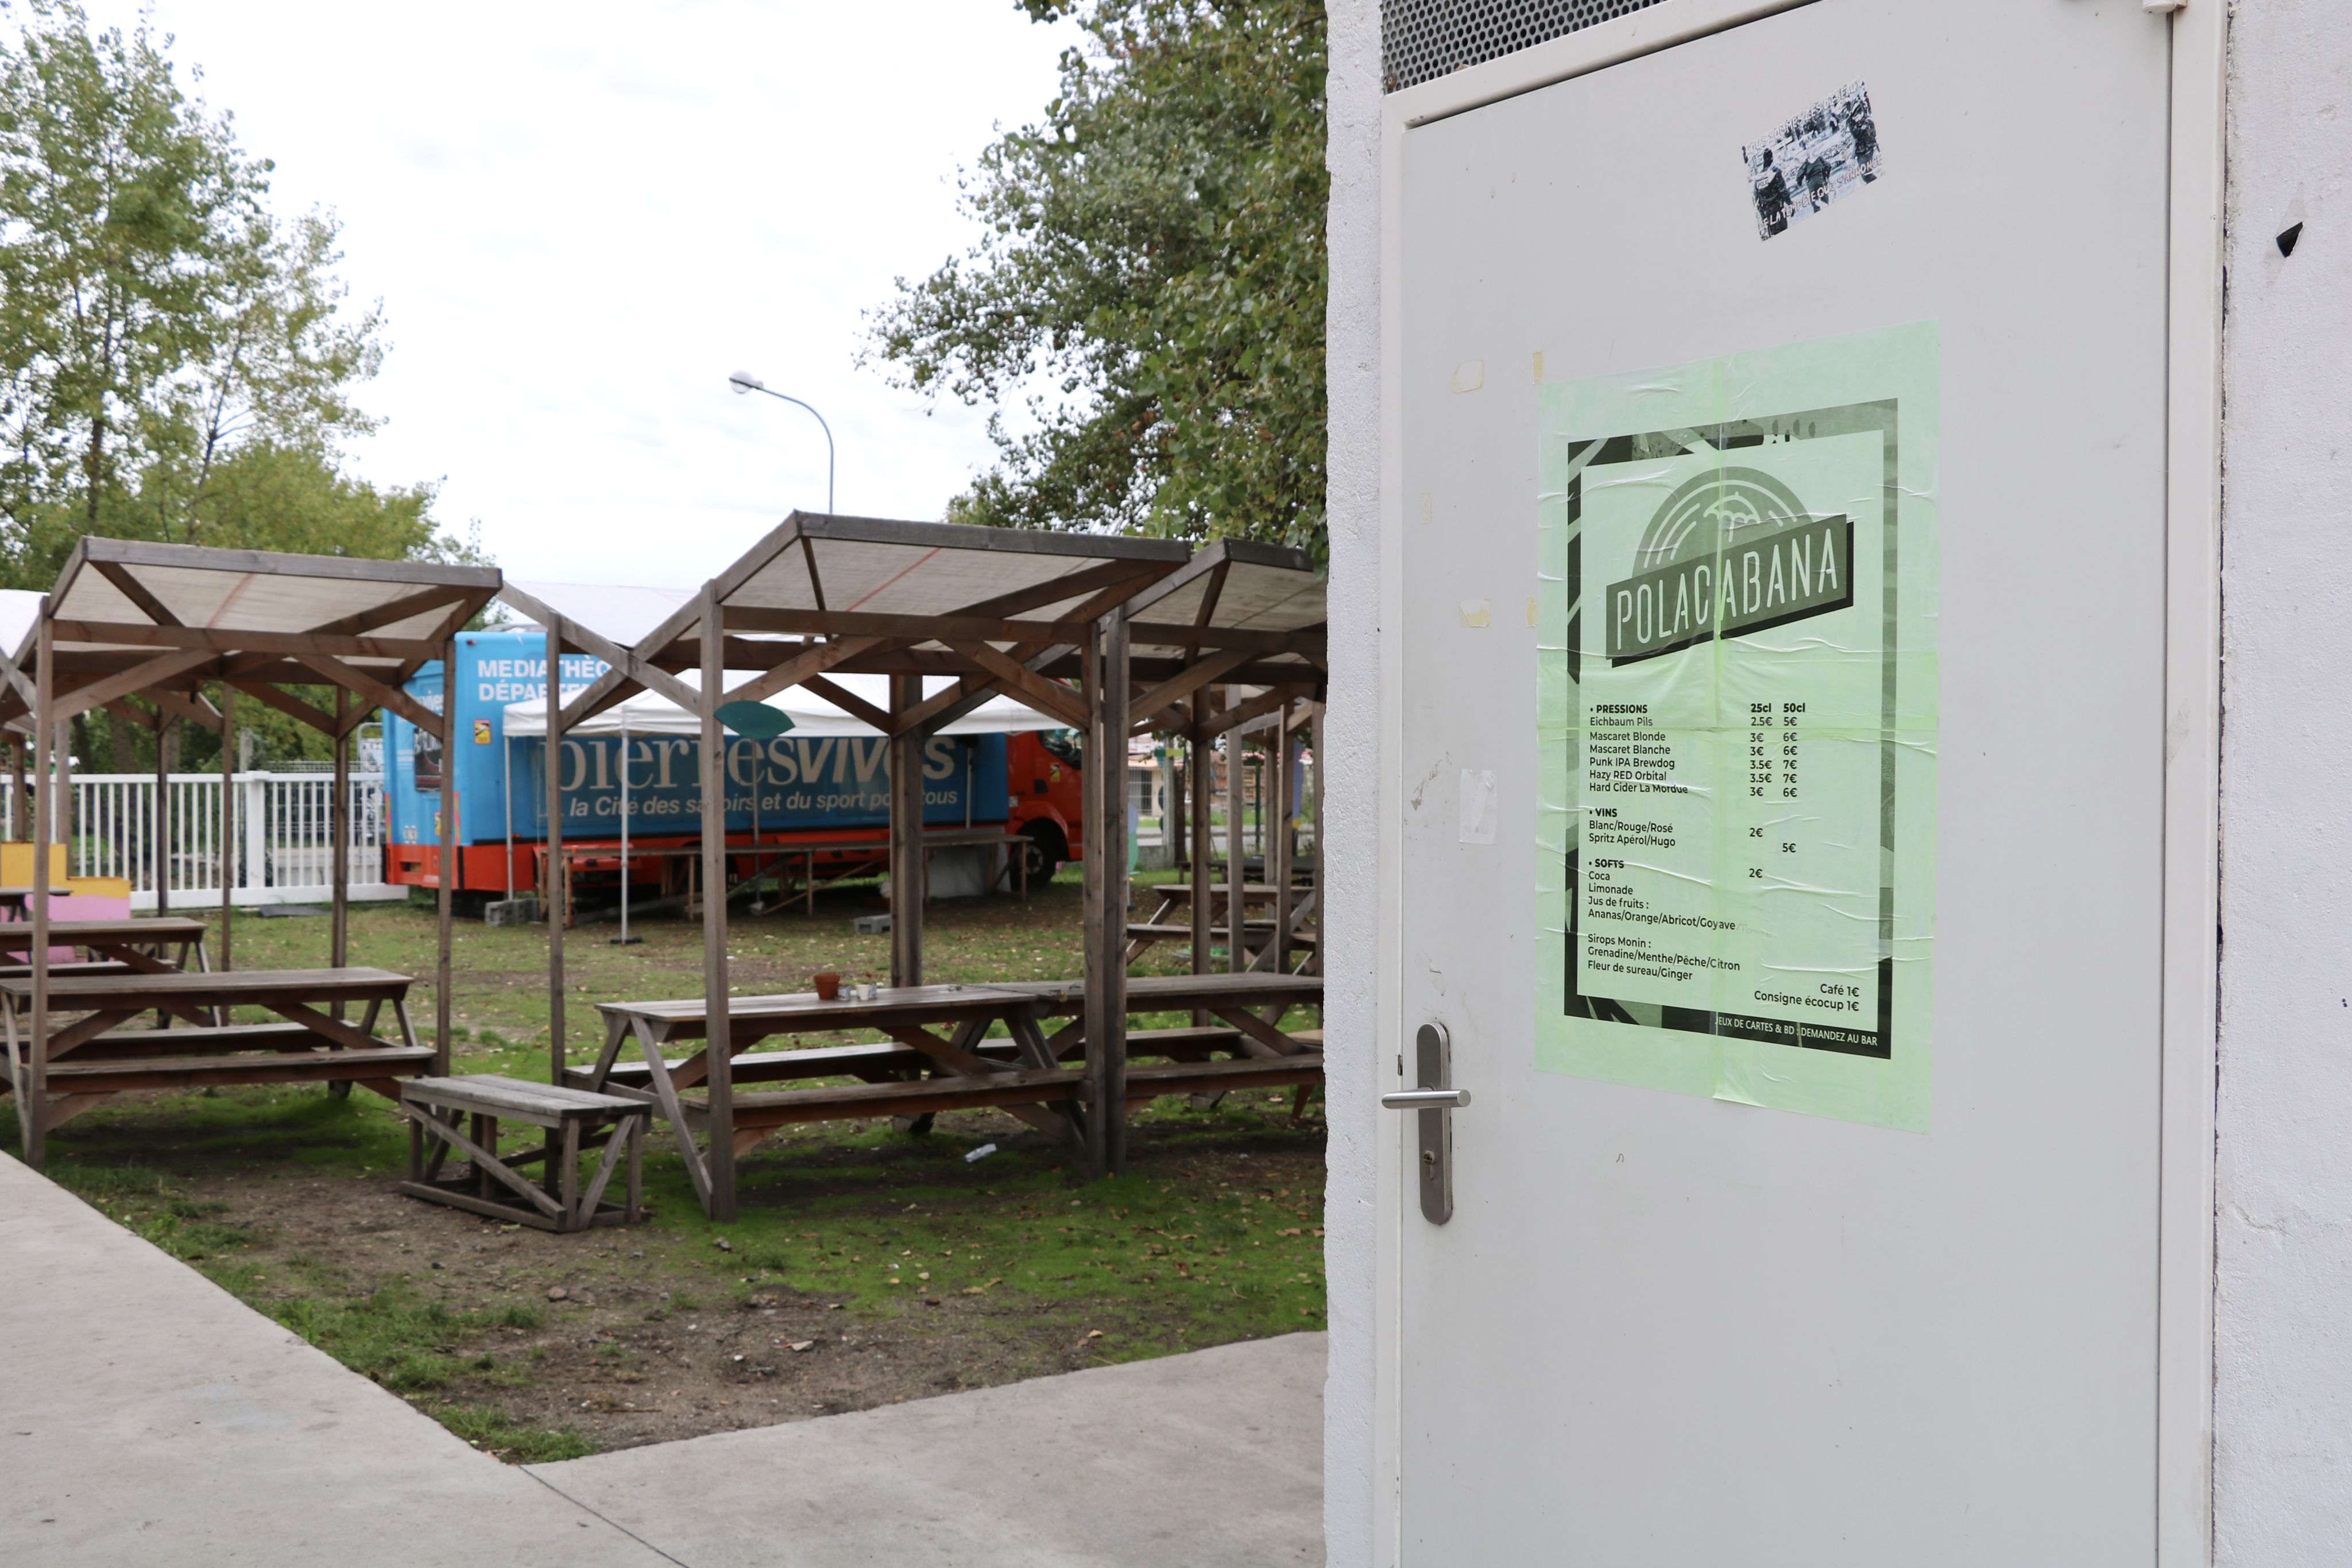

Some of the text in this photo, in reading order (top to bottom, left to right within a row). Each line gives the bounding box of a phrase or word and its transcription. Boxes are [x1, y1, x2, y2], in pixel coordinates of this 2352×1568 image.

[1617, 528, 1838, 651] POLACABANA
[1596, 704, 1648, 714] PRESSIONS
[1750, 702, 1772, 713] 25cl
[1783, 702, 1806, 713] 50cl
[1590, 716, 1653, 726] Eichbaum Pils
[1751, 716, 1773, 726] 2.5€
[1784, 716, 1798, 726] 5€
[1589, 731, 1666, 741] Mascaret Blonde
[1750, 732, 1764, 743] 3€
[1783, 731, 1798, 742] 6€
[1589, 744, 1671, 754] Mascaret Blanche
[1750, 746, 1764, 756] 3€
[1783, 745, 1798, 756] 6€
[1589, 757, 1675, 771] Punk IPA Brewdog
[1750, 760, 1773, 770] 3.5€
[1783, 759, 1797, 770] 7€
[1589, 769, 1667, 781] Hazy RED Orbital
[1750, 773, 1772, 783] 3.5€
[1783, 773, 1797, 784] 7€
[1589, 781, 1689, 794] Hard Cider La Mordue
[1750, 787, 1764, 797] 3€
[1783, 787, 1798, 797] 6€
[570, 797, 589, 817] la
[643, 796, 680, 814] des
[761, 792, 782, 811] et
[786, 791, 813, 810] du
[816, 790, 865, 812] sport
[1595, 808, 1618, 818] VINS
[1589, 819, 1673, 834] Blanc/Rouge/Rosé
[1749, 827, 1763, 838] 2€
[1589, 832, 1676, 849] Spritz Apérol/Hugo
[1782, 842, 1797, 853] 5€
[1595, 858, 1625, 869] SOFTS
[1588, 870, 1610, 881] Coca
[1748, 868, 1763, 878] 2€
[1588, 882, 1634, 895] Limonade
[1588, 896, 1604, 906] Jus
[1605, 896, 1617, 907] de
[1619, 897, 1644, 909] fruits
[1588, 908, 1736, 931] Ananas/Orange/Abricot/Goyave
[1587, 933, 1616, 947] Sirops
[1618, 936, 1646, 948] Monin
[1588, 946, 1740, 971] Grenadine/Menthe/Pêche/Citron
[1588, 959, 1693, 982] Fleur de sureau/Ginger
[1820, 983, 1860, 997] Café 1€
[1754, 990, 1859, 1012] Consigne écocup 1€
[1715, 1017, 1732, 1027] JEUX
[1734, 1019, 1744, 1028] DE
[1746, 1020, 1773, 1032] CARTES
[1775, 1024, 1782, 1033] &
[1784, 1025, 1794, 1035] BD
[1801, 1027, 1845, 1042] DEMANDEZ
[1847, 1034, 1859, 1043] AU
[1861, 1036, 1878, 1046] BAR
